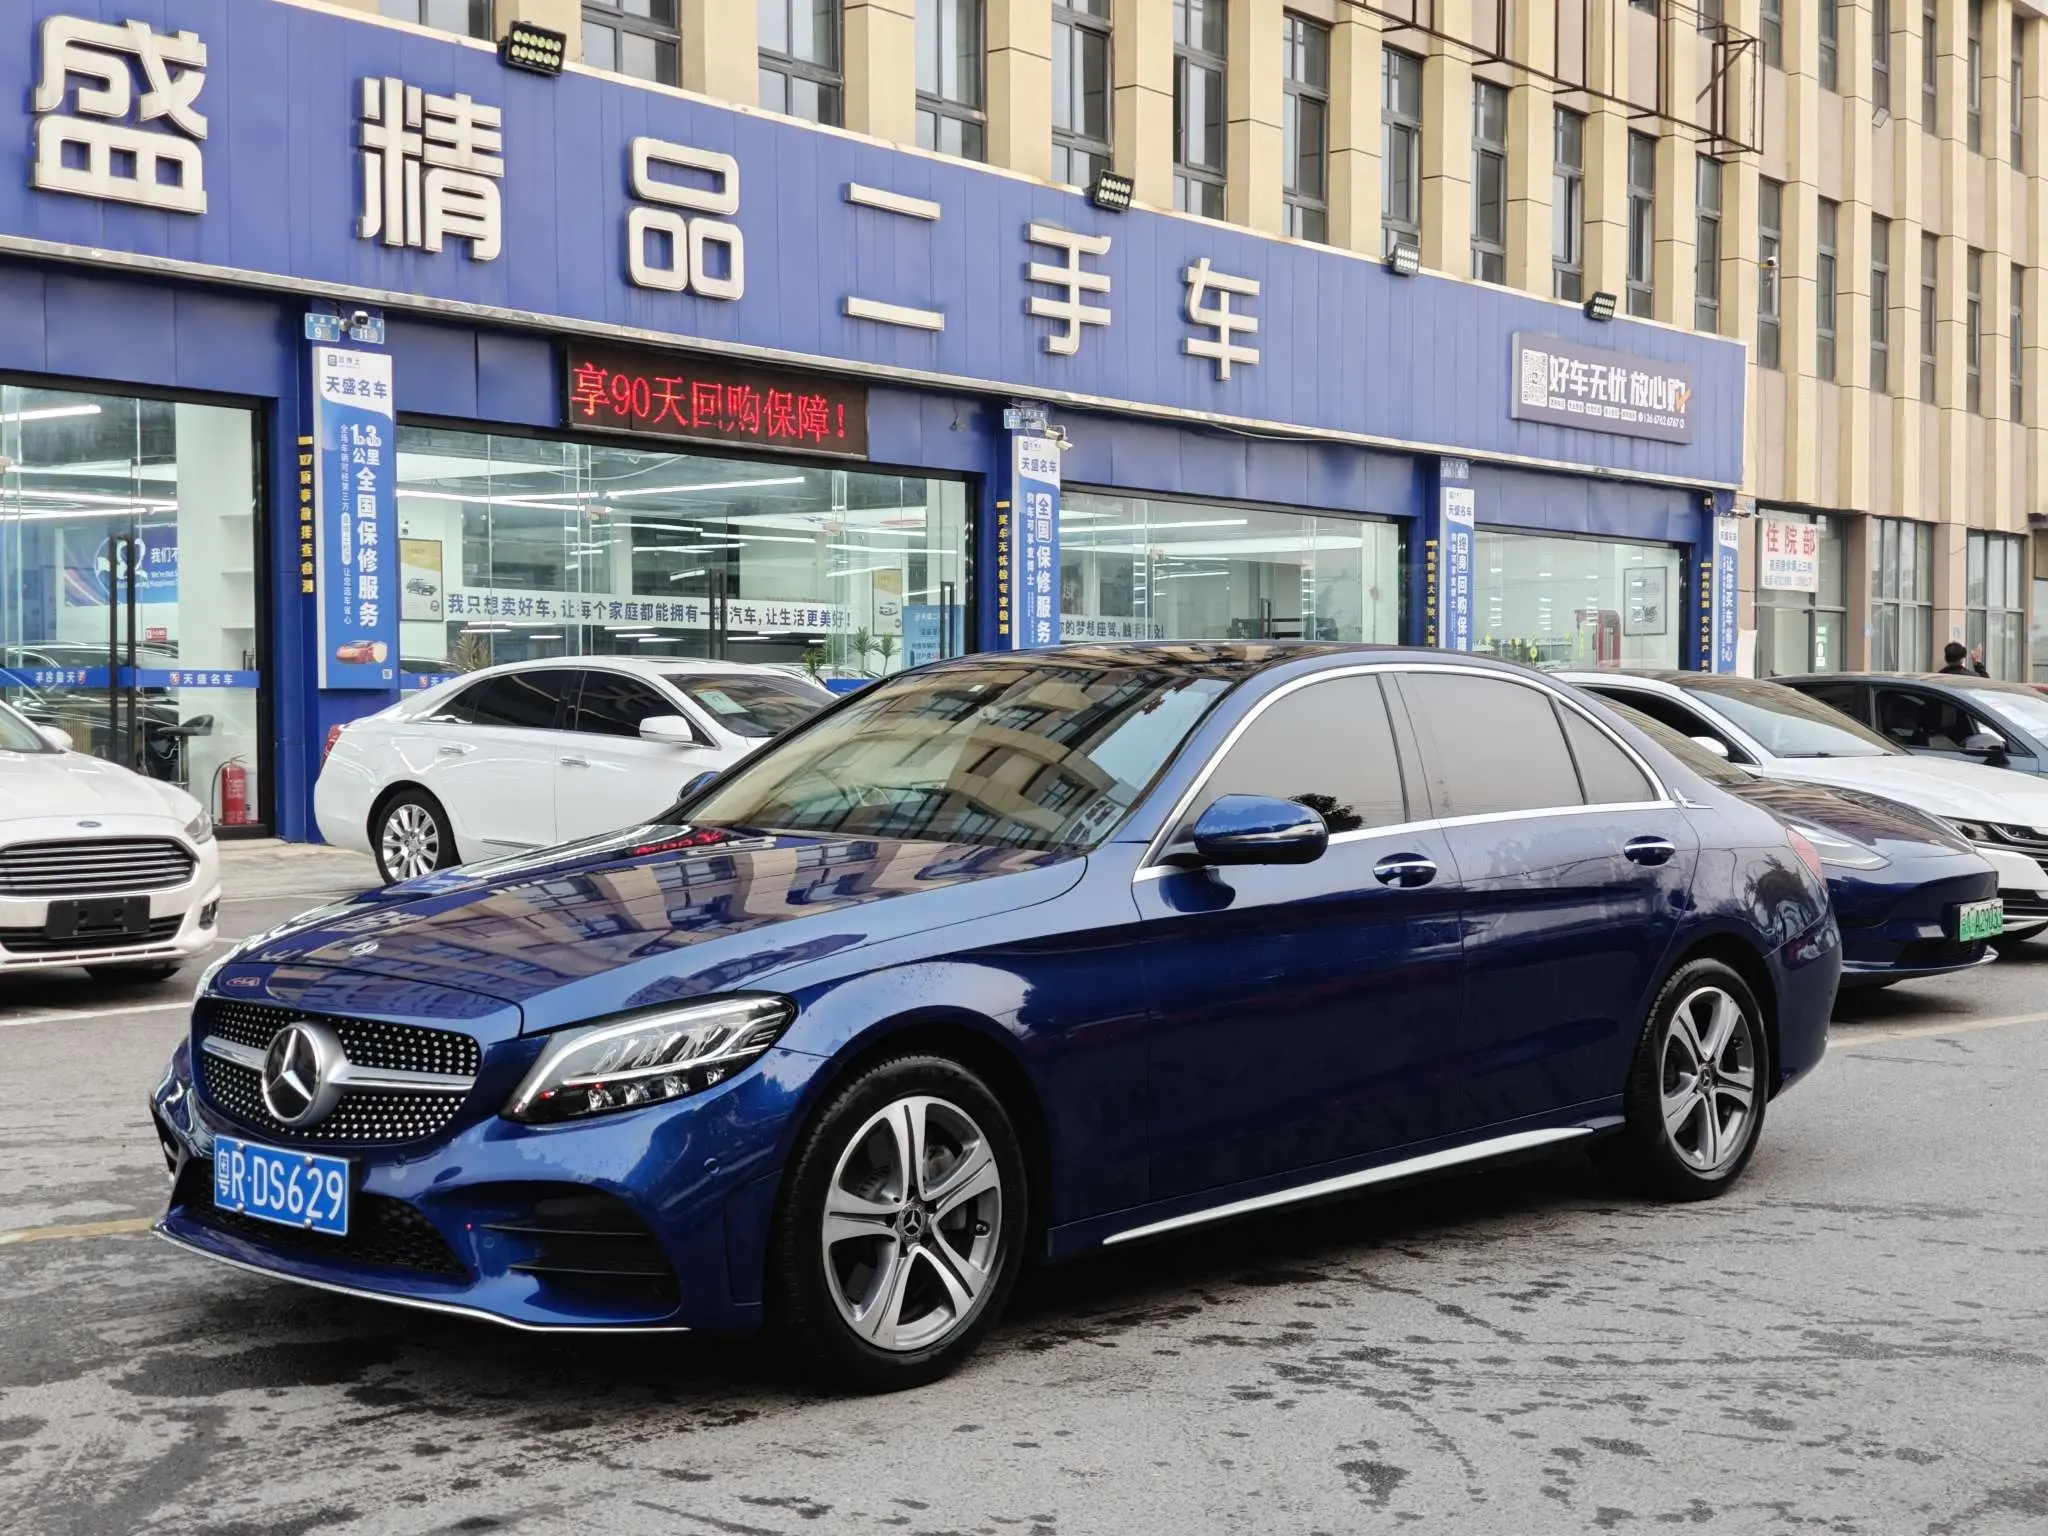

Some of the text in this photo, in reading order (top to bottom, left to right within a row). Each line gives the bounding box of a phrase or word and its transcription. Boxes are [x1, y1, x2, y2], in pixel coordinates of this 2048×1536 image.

[325, 375, 387, 399] 天盛名车
[571, 362, 845, 442] 享90天回购保障！
[1549, 354, 1628, 404] 好车无忧
[1766, 521, 1817, 556] 住院部
[1036, 495, 1051, 643] 全国保修服务
